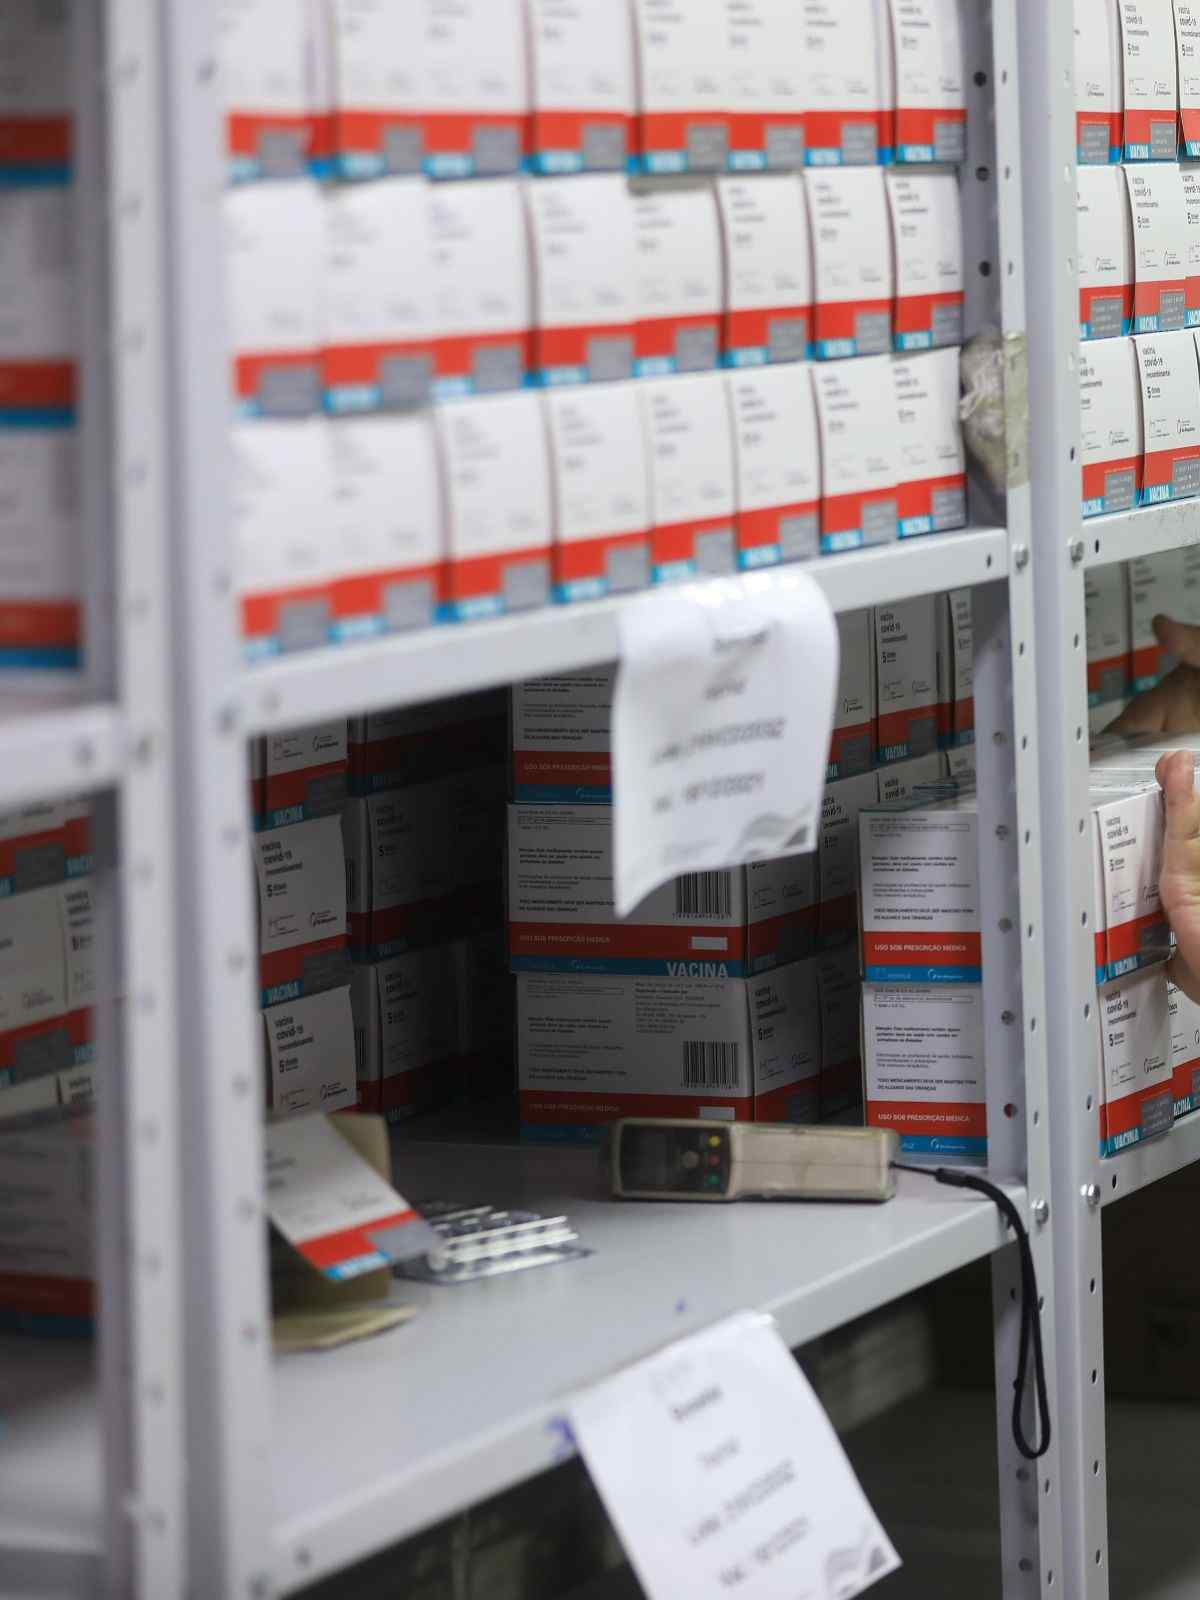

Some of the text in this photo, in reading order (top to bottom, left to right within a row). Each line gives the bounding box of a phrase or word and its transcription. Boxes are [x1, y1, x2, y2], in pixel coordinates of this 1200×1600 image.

[1144, 357, 1164, 367] covid-19
[1147, 386, 1152, 399] 5
[1149, 485, 1169, 500] VACINA
[884, 743, 907, 761] VACINA
[1107, 826, 1129, 839] covid-19
[264, 851, 293, 865] covid-19
[267, 884, 272, 897] 5
[666, 962, 728, 978] VACINA
[1107, 1000, 1129, 1014] covid-19
[276, 1027, 304, 1041] covid-19
[1109, 1033, 1114, 1047] 5
[279, 1060, 285, 1074] 5
[1173, 1098, 1191, 1116] ACINA
[1114, 1129, 1139, 1148] VACINA
